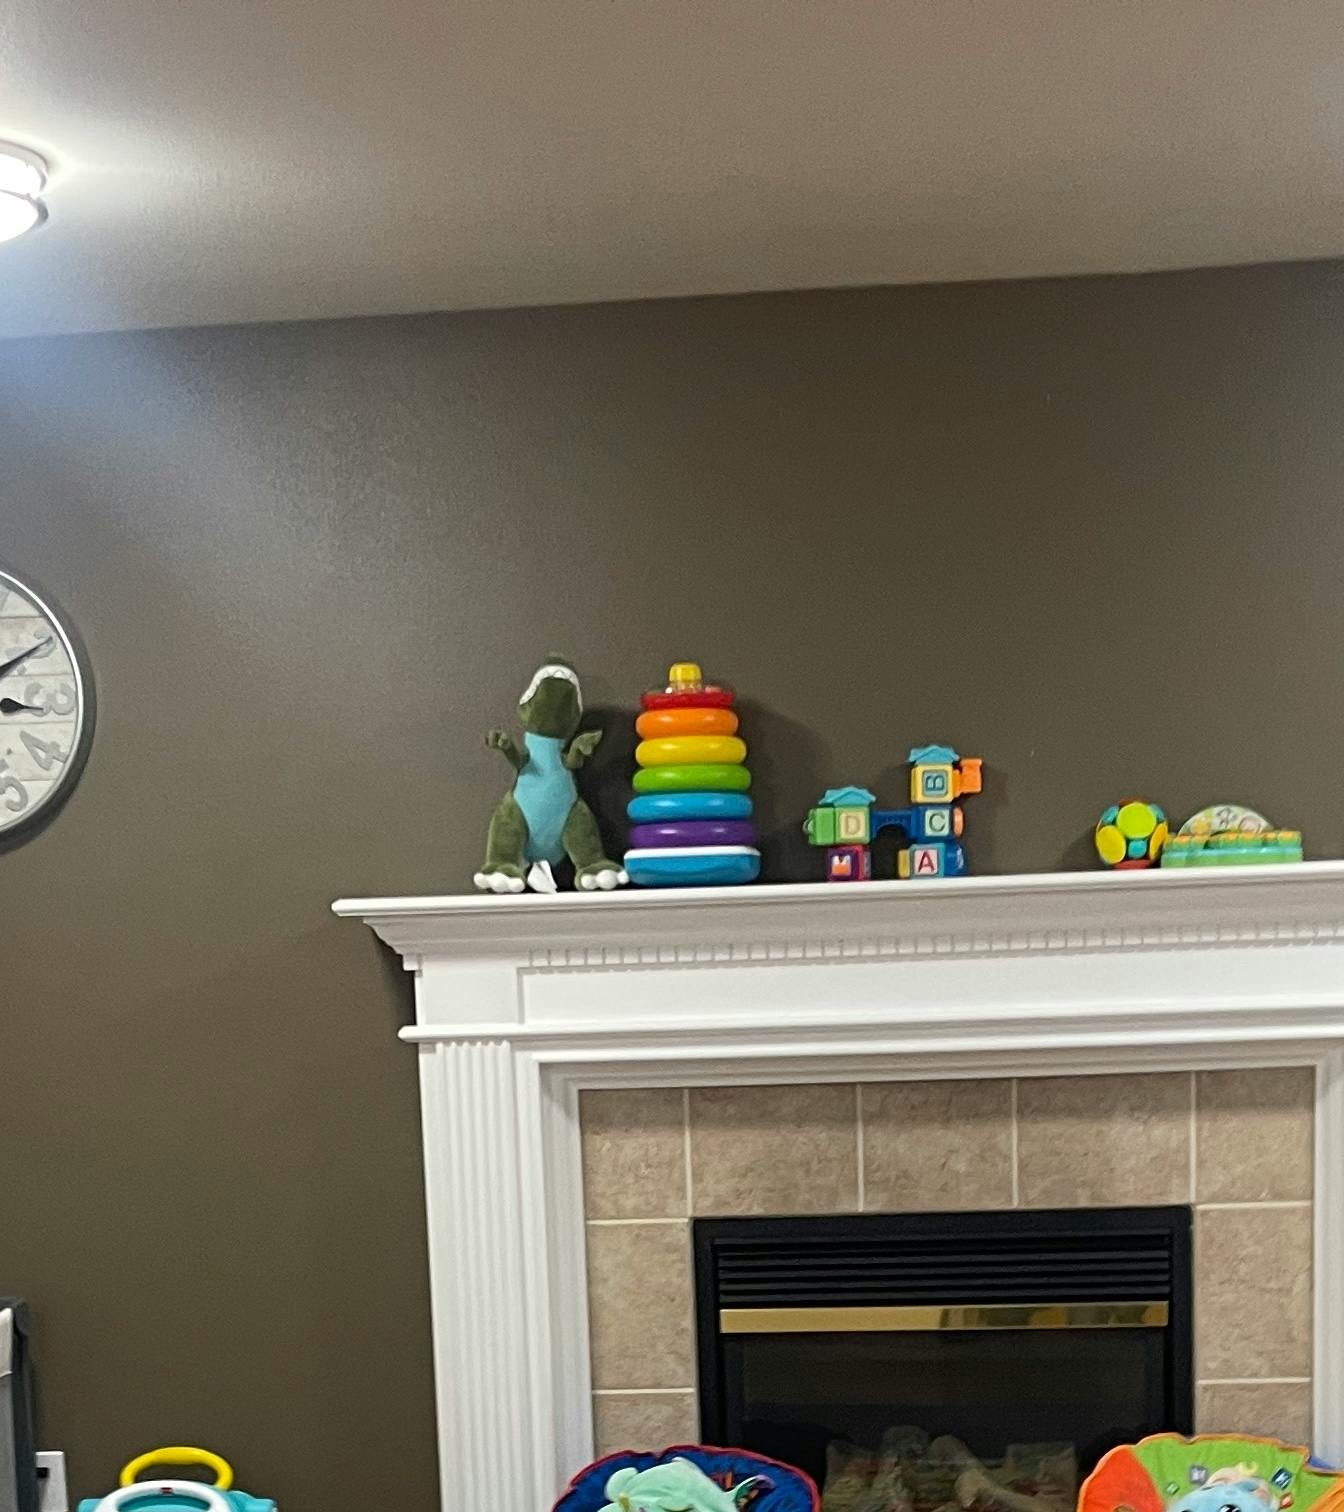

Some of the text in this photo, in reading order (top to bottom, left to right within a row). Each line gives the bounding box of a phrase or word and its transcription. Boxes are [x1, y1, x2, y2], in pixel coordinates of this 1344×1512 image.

[23, 680, 76, 717] 3
[19, 730, 67, 771] 4
[925, 774, 945, 792] B
[844, 815, 861, 835] D
[928, 812, 946, 832] C
[917, 850, 935, 872] A
